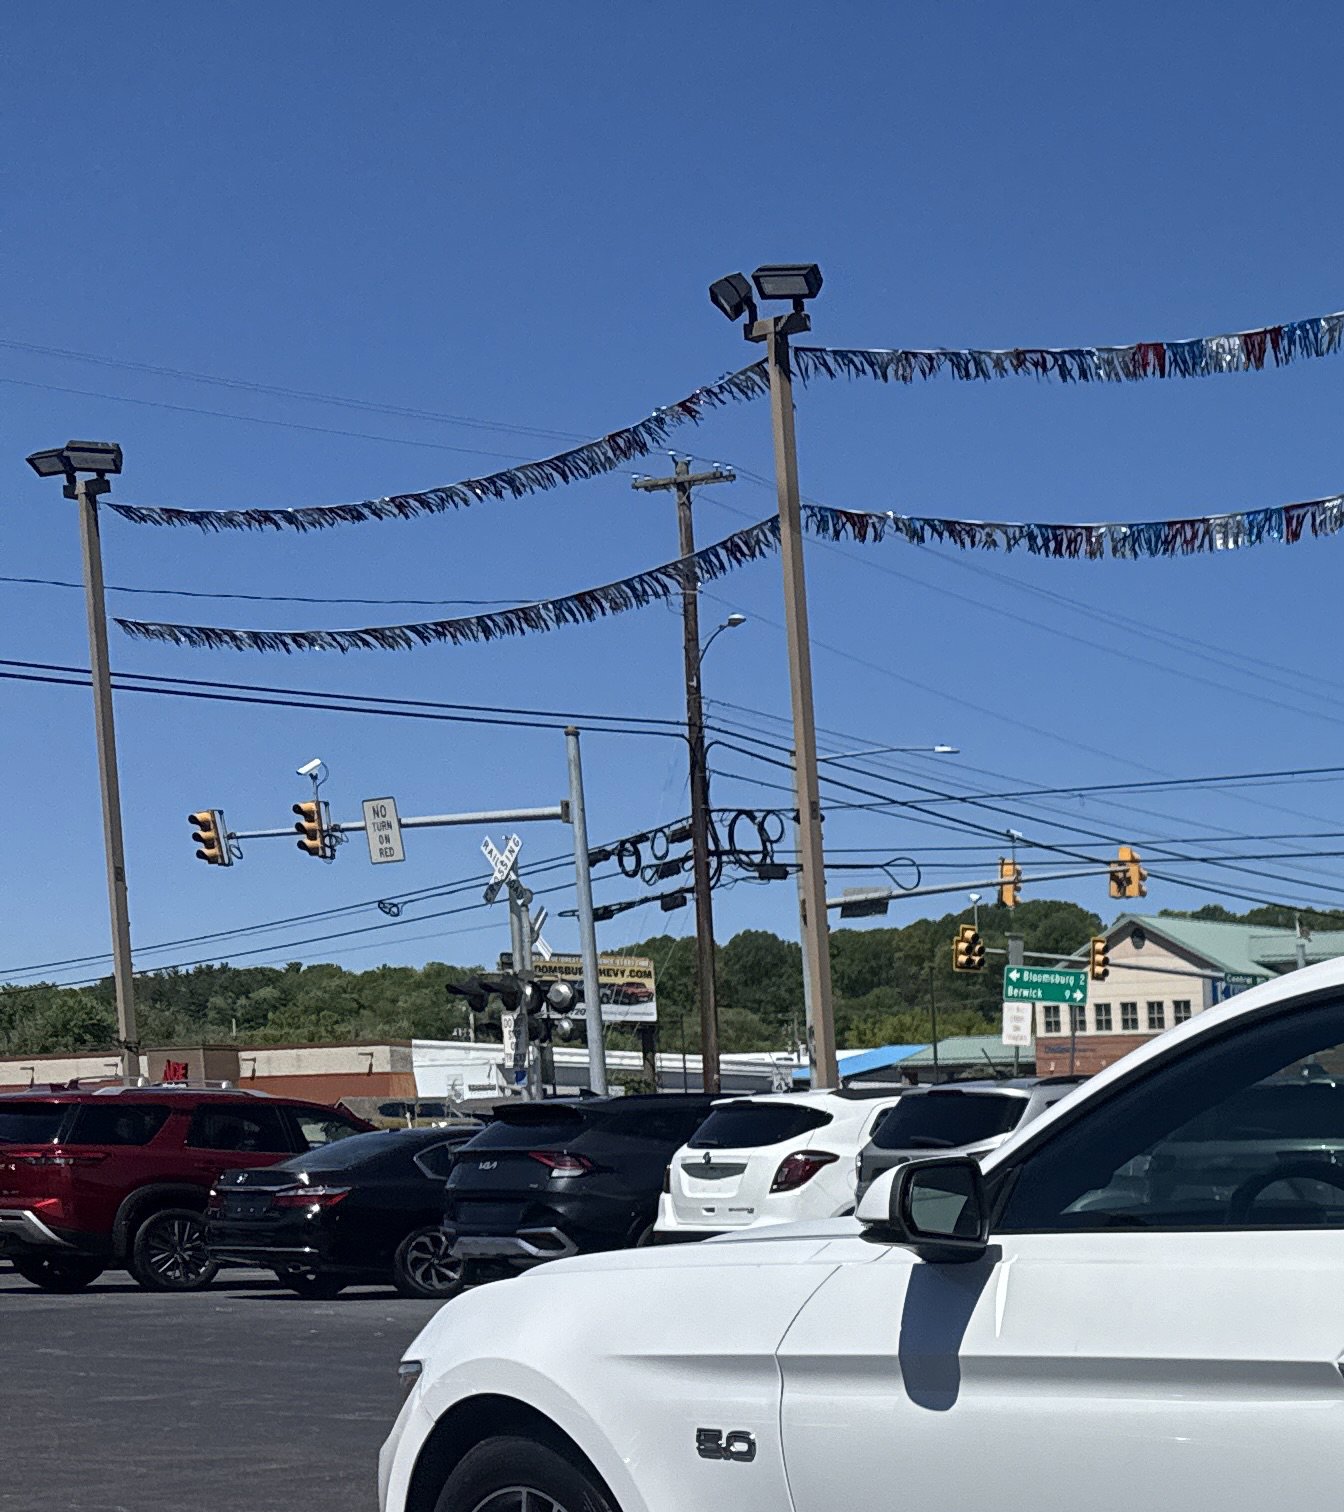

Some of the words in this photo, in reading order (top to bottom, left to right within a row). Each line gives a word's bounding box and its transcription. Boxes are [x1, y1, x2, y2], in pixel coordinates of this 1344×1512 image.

[371, 804, 387, 819] NO
[371, 820, 393, 832] TURN
[378, 833, 391, 845] ON
[378, 847, 395, 858] RED
[1023, 970, 1075, 988] Bloomsburg
[1079, 974, 1086, 986] 2
[1007, 985, 1043, 998] Berwick
[1064, 989, 1071, 1000] 9
[696, 1427, 757, 1463] 5.0
